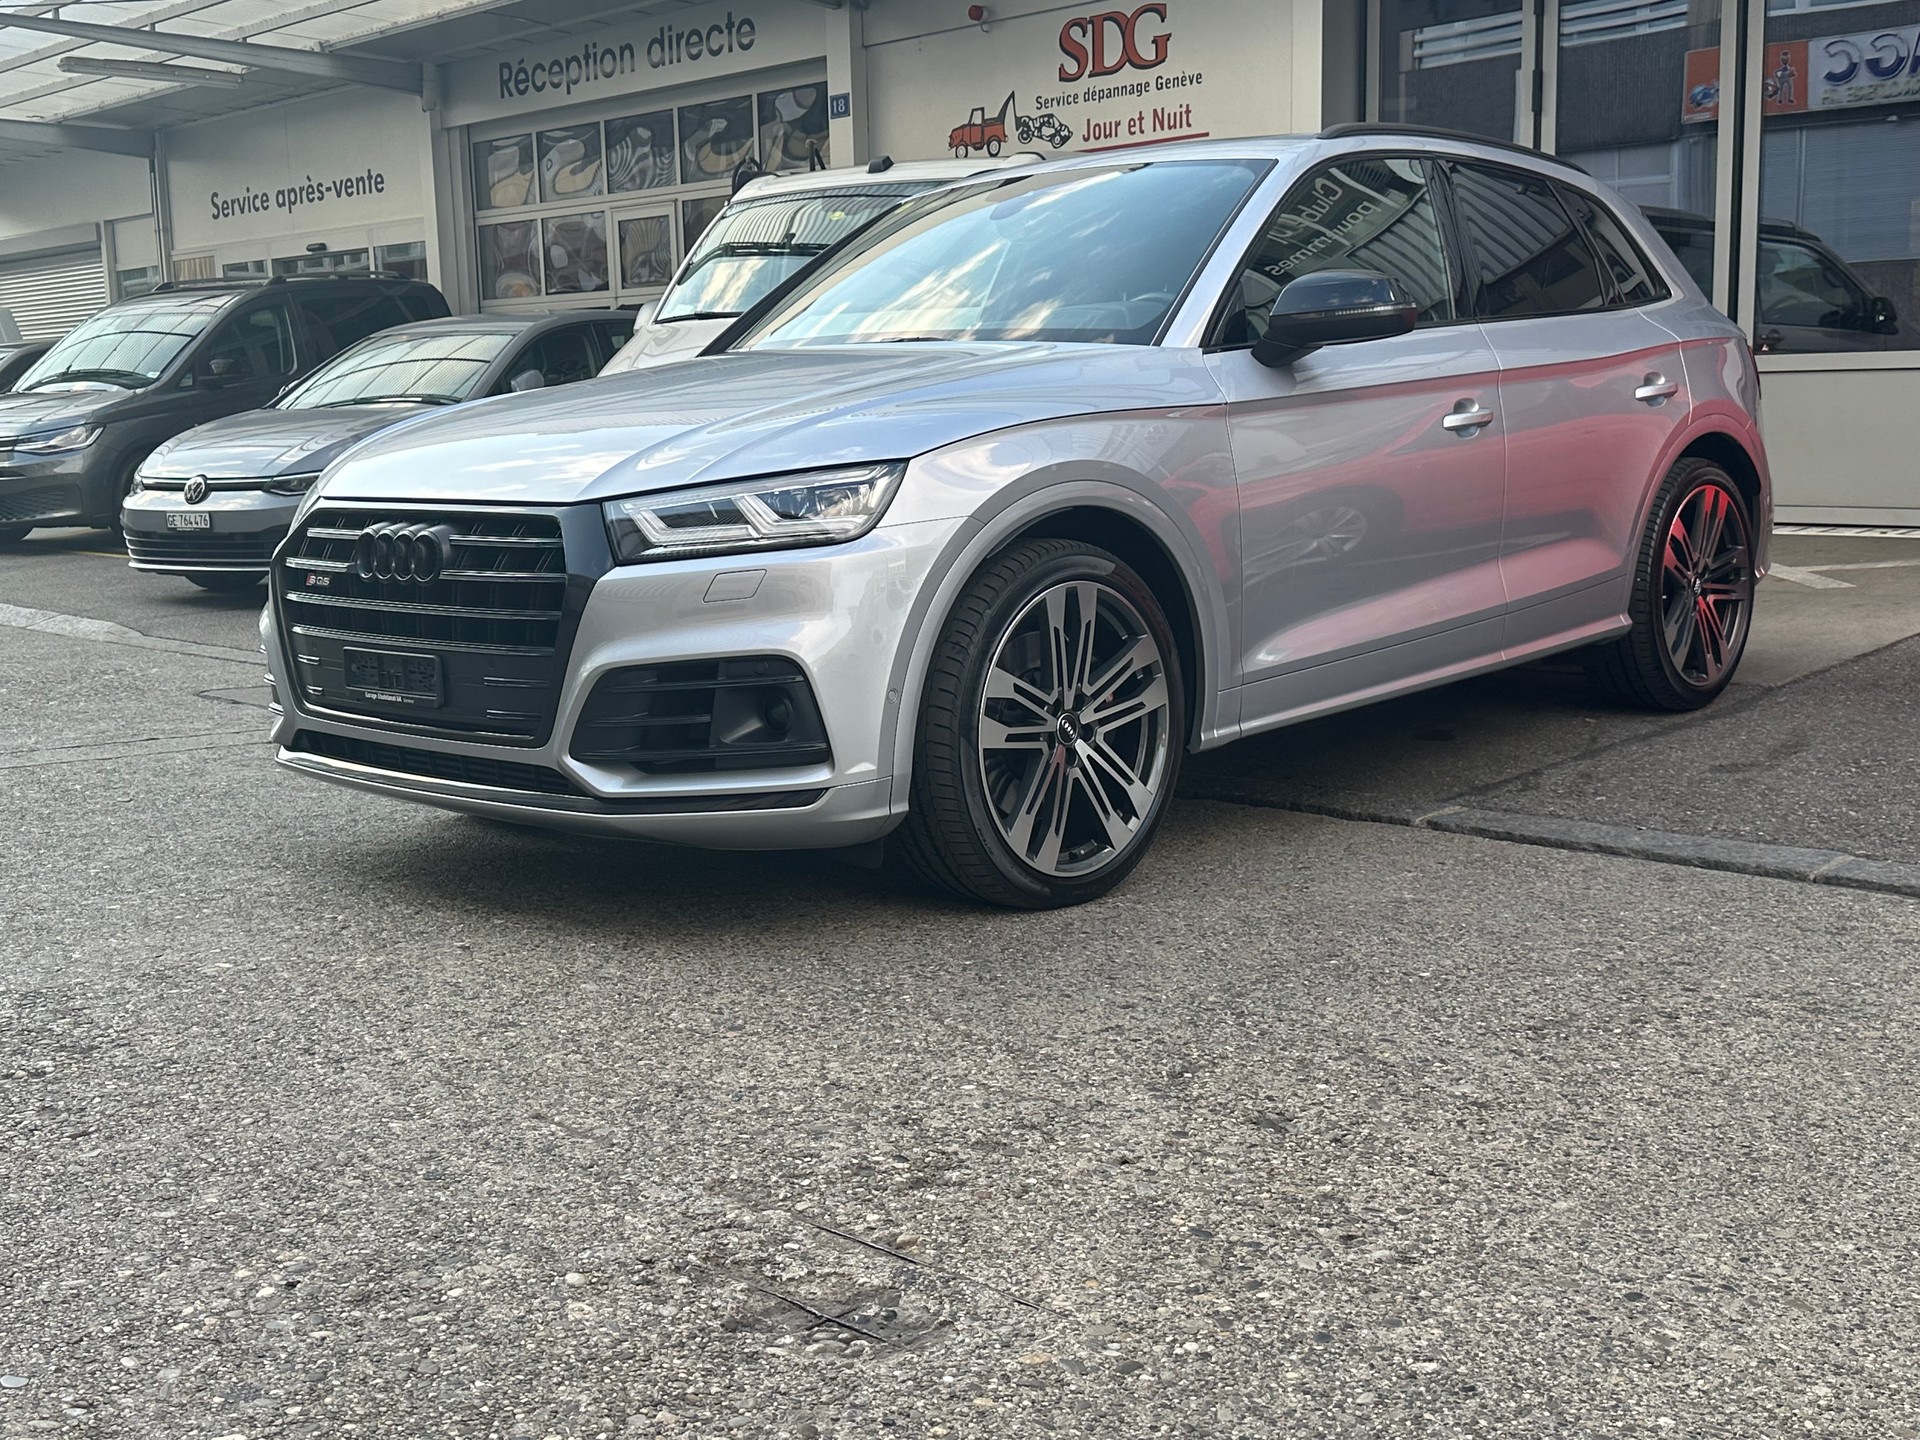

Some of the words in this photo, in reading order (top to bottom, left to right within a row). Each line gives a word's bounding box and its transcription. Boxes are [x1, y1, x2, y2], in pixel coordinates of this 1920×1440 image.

[499, 42, 636, 99] Réception
[646, 11, 756, 69] directe
[1058, 3, 1172, 82] SDG
[833, 98, 845, 114] 18
[1036, 91, 1079, 110] Service
[1083, 85, 1150, 103] dépannage
[1155, 71, 1203, 91] Genève
[1082, 118, 1121, 143] Jour
[1127, 110, 1145, 136] et
[1152, 103, 1192, 133] Nuit
[210, 186, 270, 220] Service
[275, 168, 385, 214] après-vente
[167, 514, 178, 527] GE
[308, 574, 330, 586] SQ5
